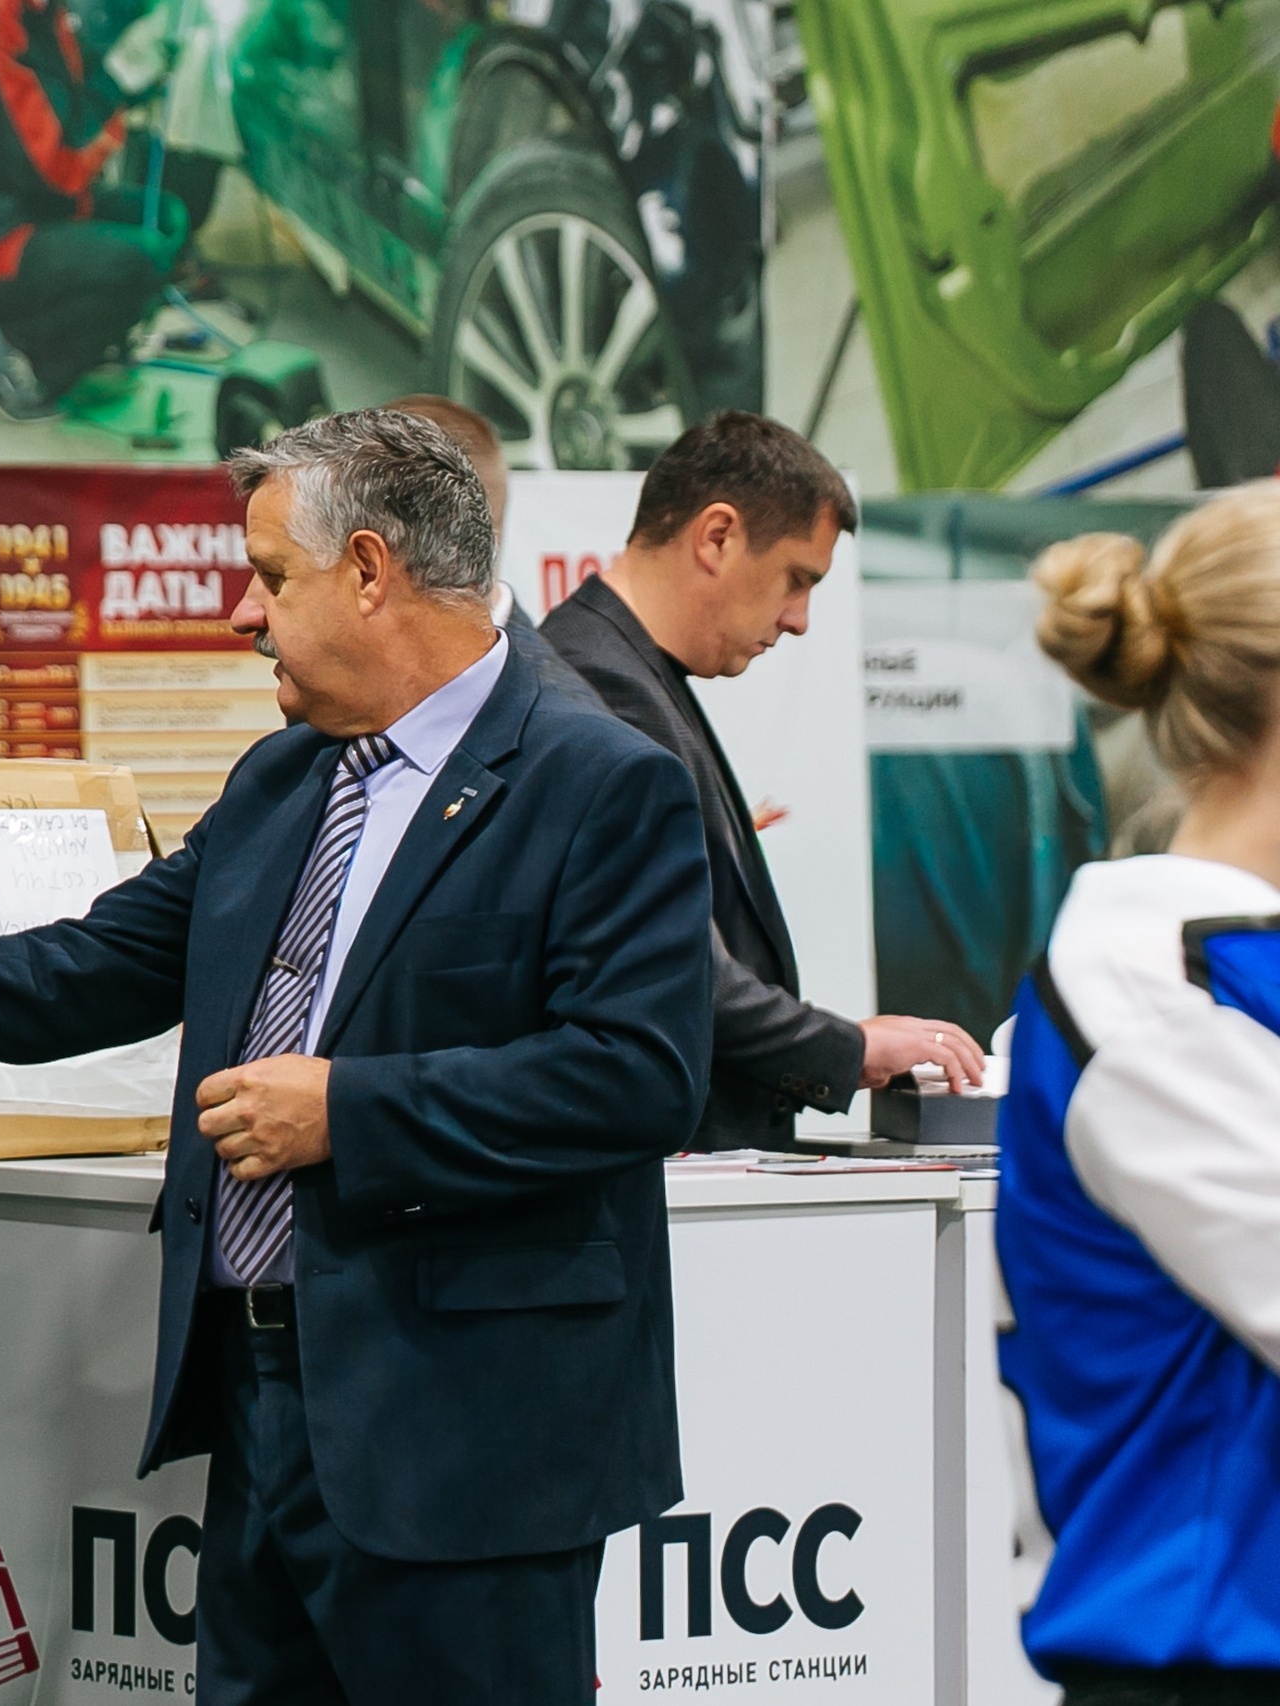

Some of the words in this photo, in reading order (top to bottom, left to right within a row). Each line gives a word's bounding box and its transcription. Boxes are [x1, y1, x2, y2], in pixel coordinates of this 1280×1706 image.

[99, 523, 248, 569] ВАЖН
[100, 570, 223, 620] ДАТЫ
[72, 1505, 204, 1646] ПС
[639, 1502, 865, 1641] ПСС
[71, 1657, 175, 1693] ЗАРЯДНЫЕ
[639, 1661, 757, 1691] ЗАРЯДНЫЕ
[769, 1654, 868, 1682] СТАНЦИИ
